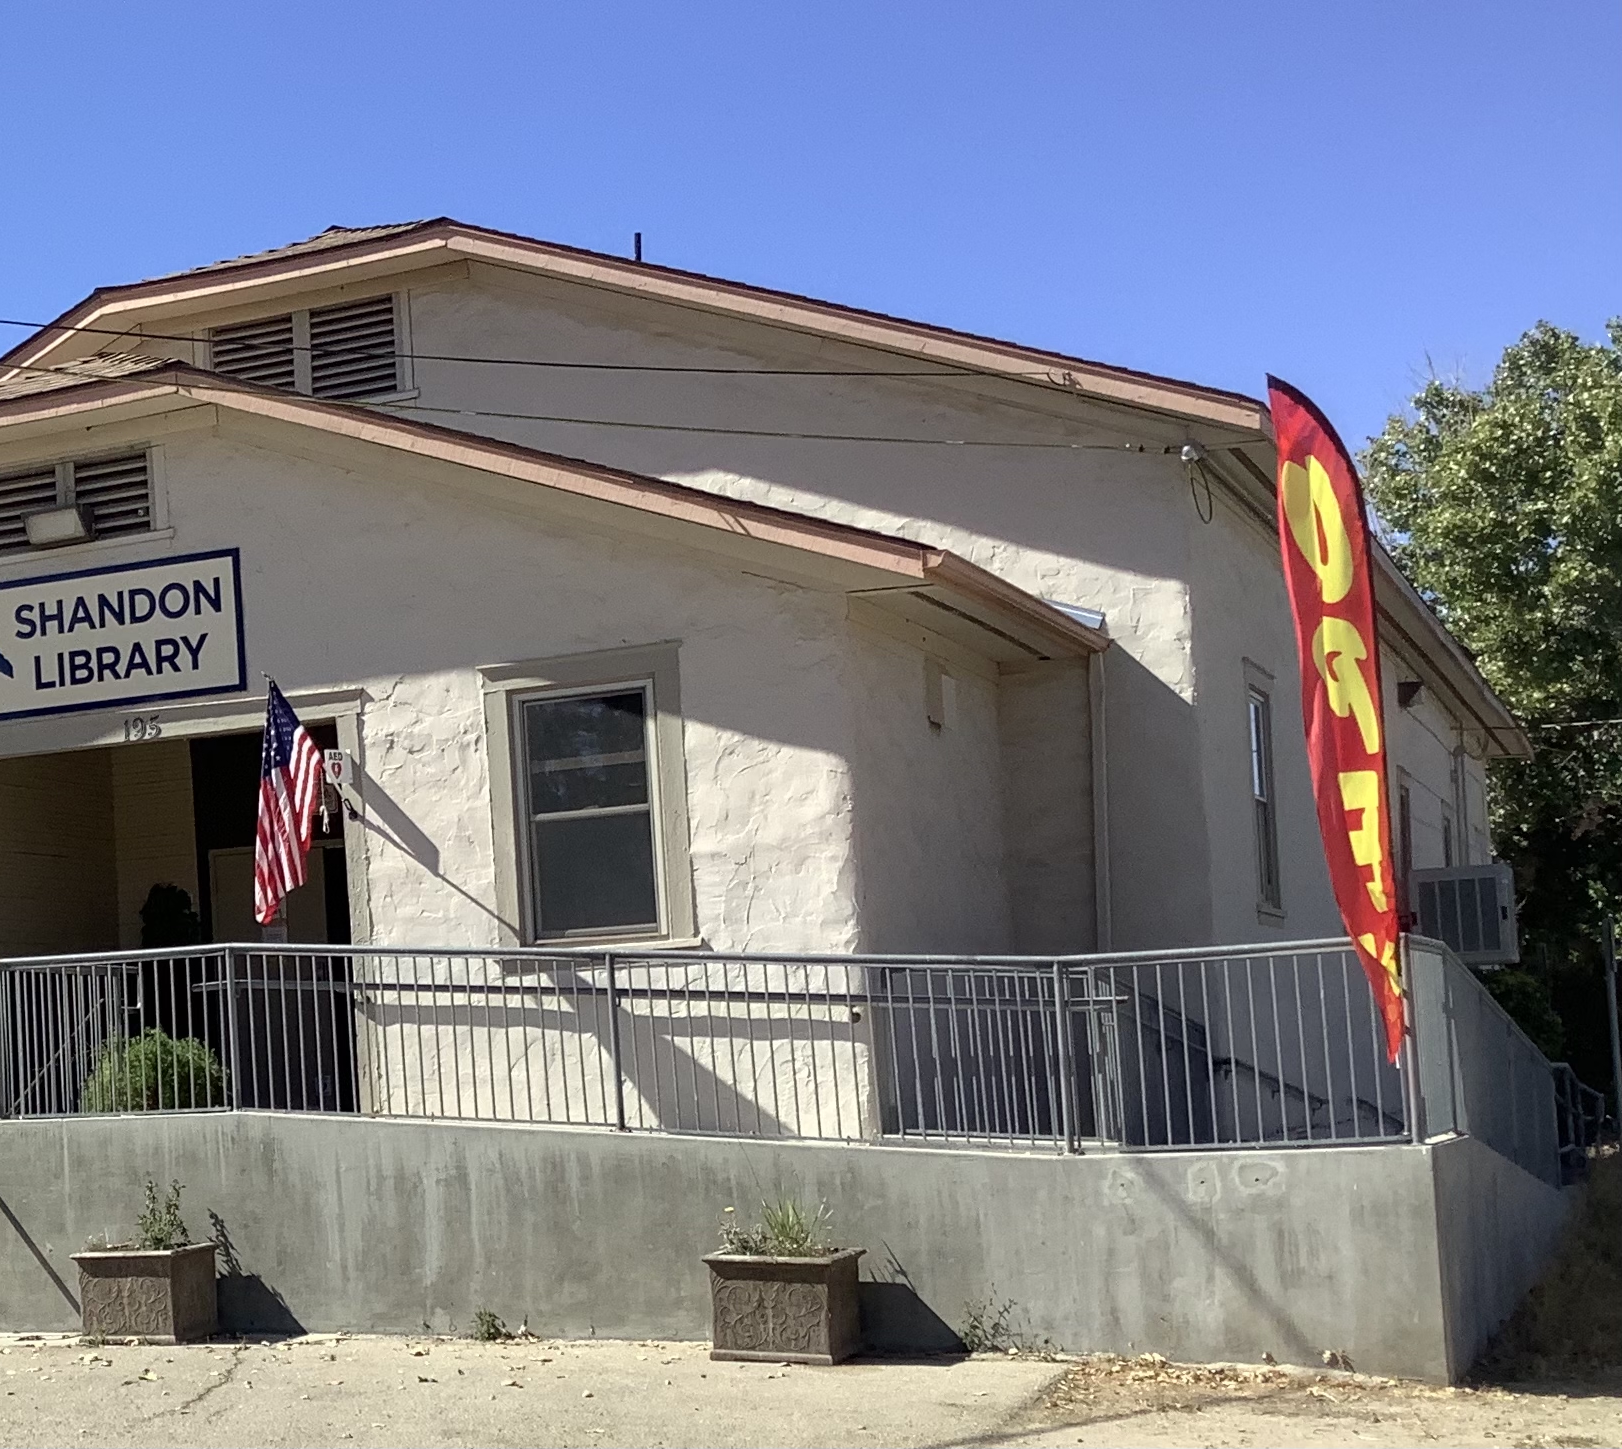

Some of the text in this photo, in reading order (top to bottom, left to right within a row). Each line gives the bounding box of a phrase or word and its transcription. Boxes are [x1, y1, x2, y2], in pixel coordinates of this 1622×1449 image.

[15, 577, 222, 639] SHANDON
[34, 633, 208, 690] LIBRARY
[124, 715, 162, 740] 195
[329, 752, 343, 761] AED
